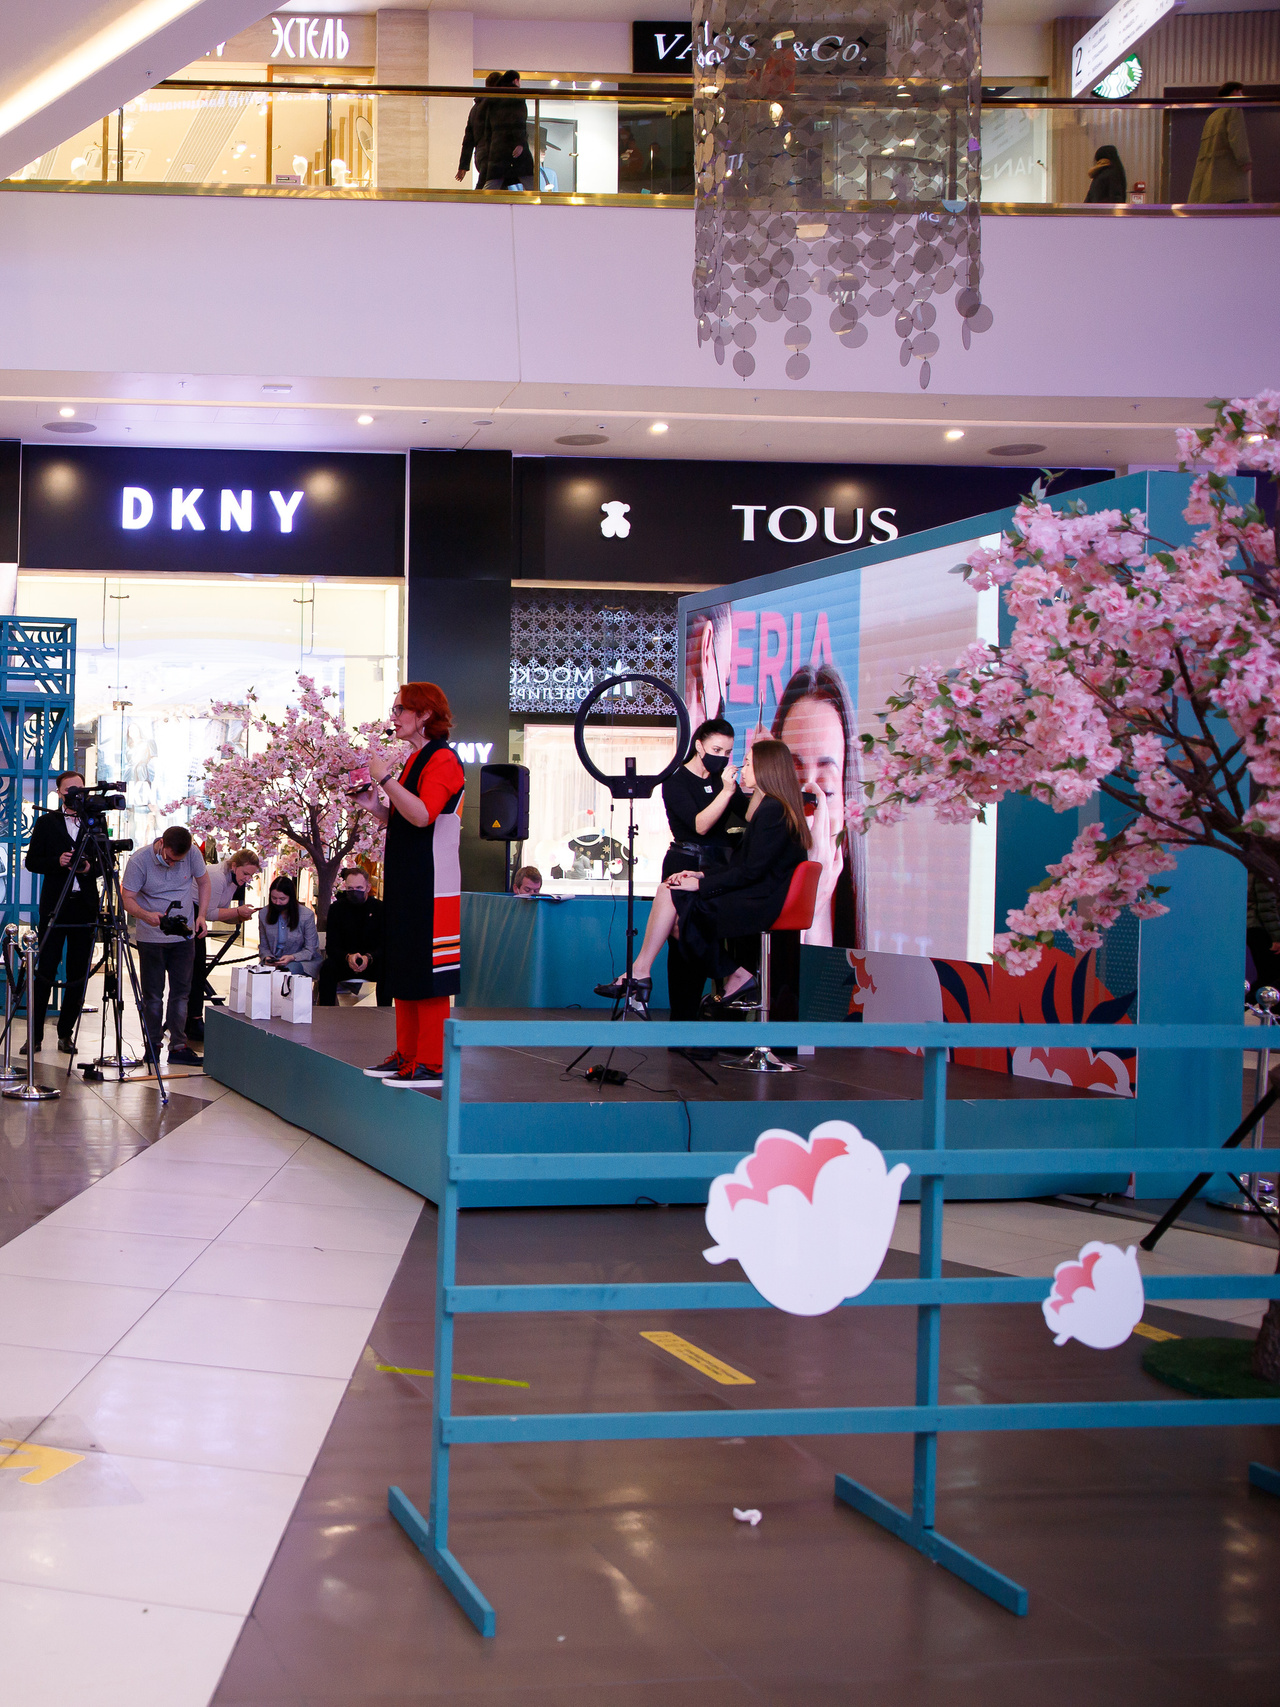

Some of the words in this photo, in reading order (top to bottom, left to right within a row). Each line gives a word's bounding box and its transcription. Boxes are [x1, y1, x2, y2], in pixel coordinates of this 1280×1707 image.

[270, 17, 350, 60] ЭСТЕЛЬ
[121, 486, 305, 534] DKNY
[731, 504, 899, 545] TOUS
[449, 742, 494, 763] NY
